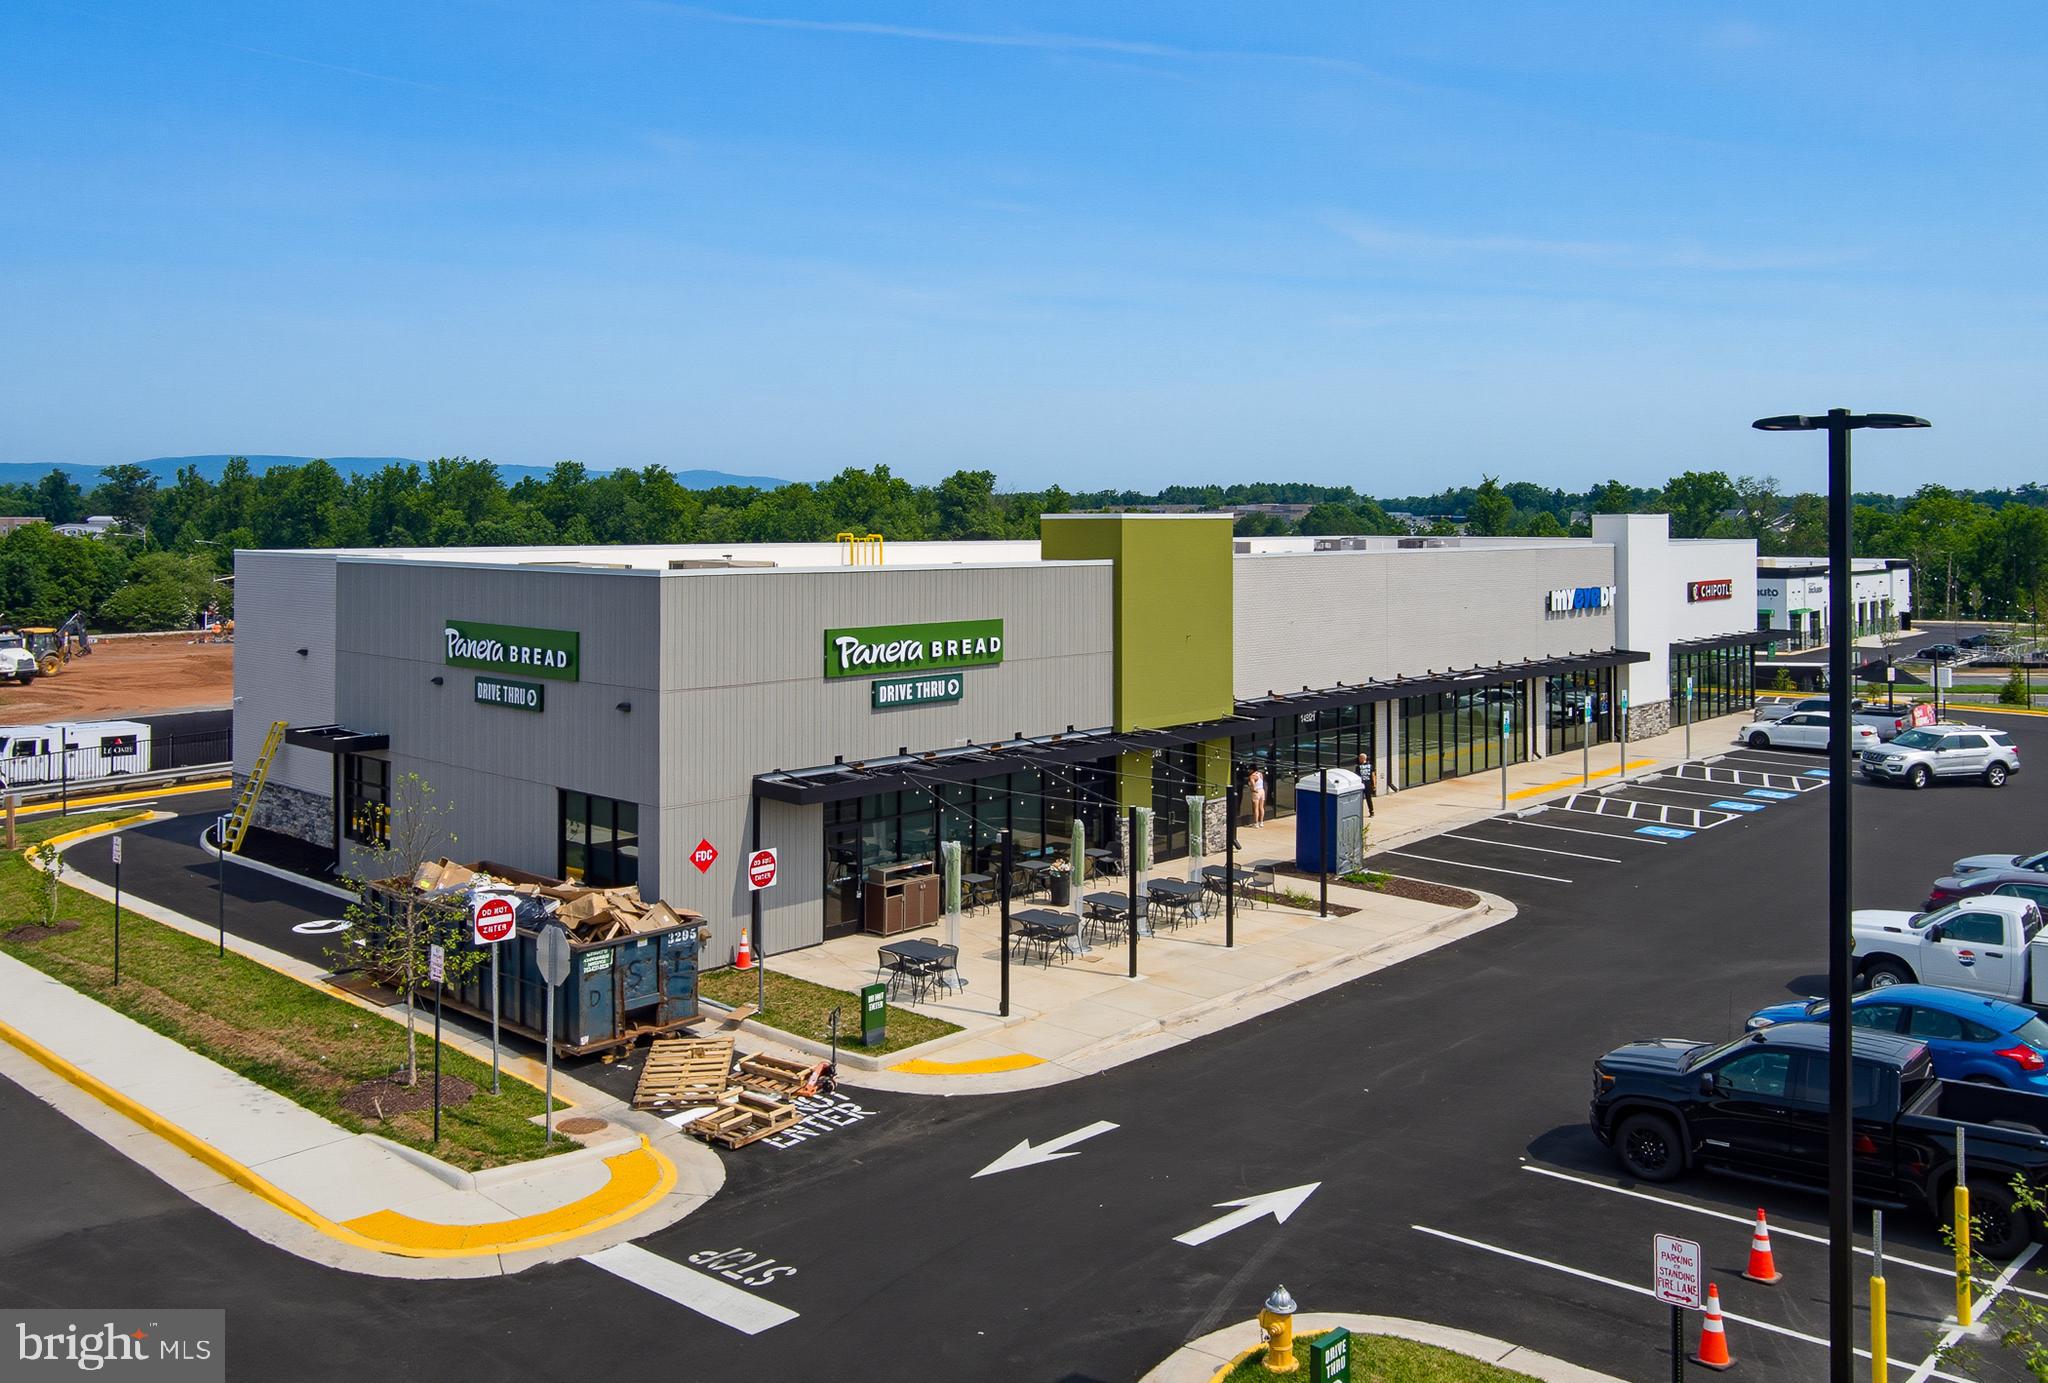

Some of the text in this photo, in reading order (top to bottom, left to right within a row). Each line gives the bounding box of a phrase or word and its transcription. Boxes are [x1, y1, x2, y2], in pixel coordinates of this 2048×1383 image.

[445, 627, 567, 668] Panera BREAD
[835, 636, 1001, 669] Panera BREAD
[477, 682, 526, 705] DRIVE THRU
[879, 679, 946, 703] DRIVE THRU
[695, 849, 713, 862] FDC
[482, 906, 508, 917] DO NOT
[761, 1102, 880, 1149] ENTER
[1661, 1251, 1694, 1267] PARKING
[1671, 1242, 1683, 1254] NO
[688, 1247, 797, 1286] STOP
[1659, 1266, 1696, 1283] STANDING
[1657, 1276, 1699, 1296] FIRE LANE
[1325, 1338, 1346, 1365] DRIVE
[1326, 1355, 1346, 1379] THRU
